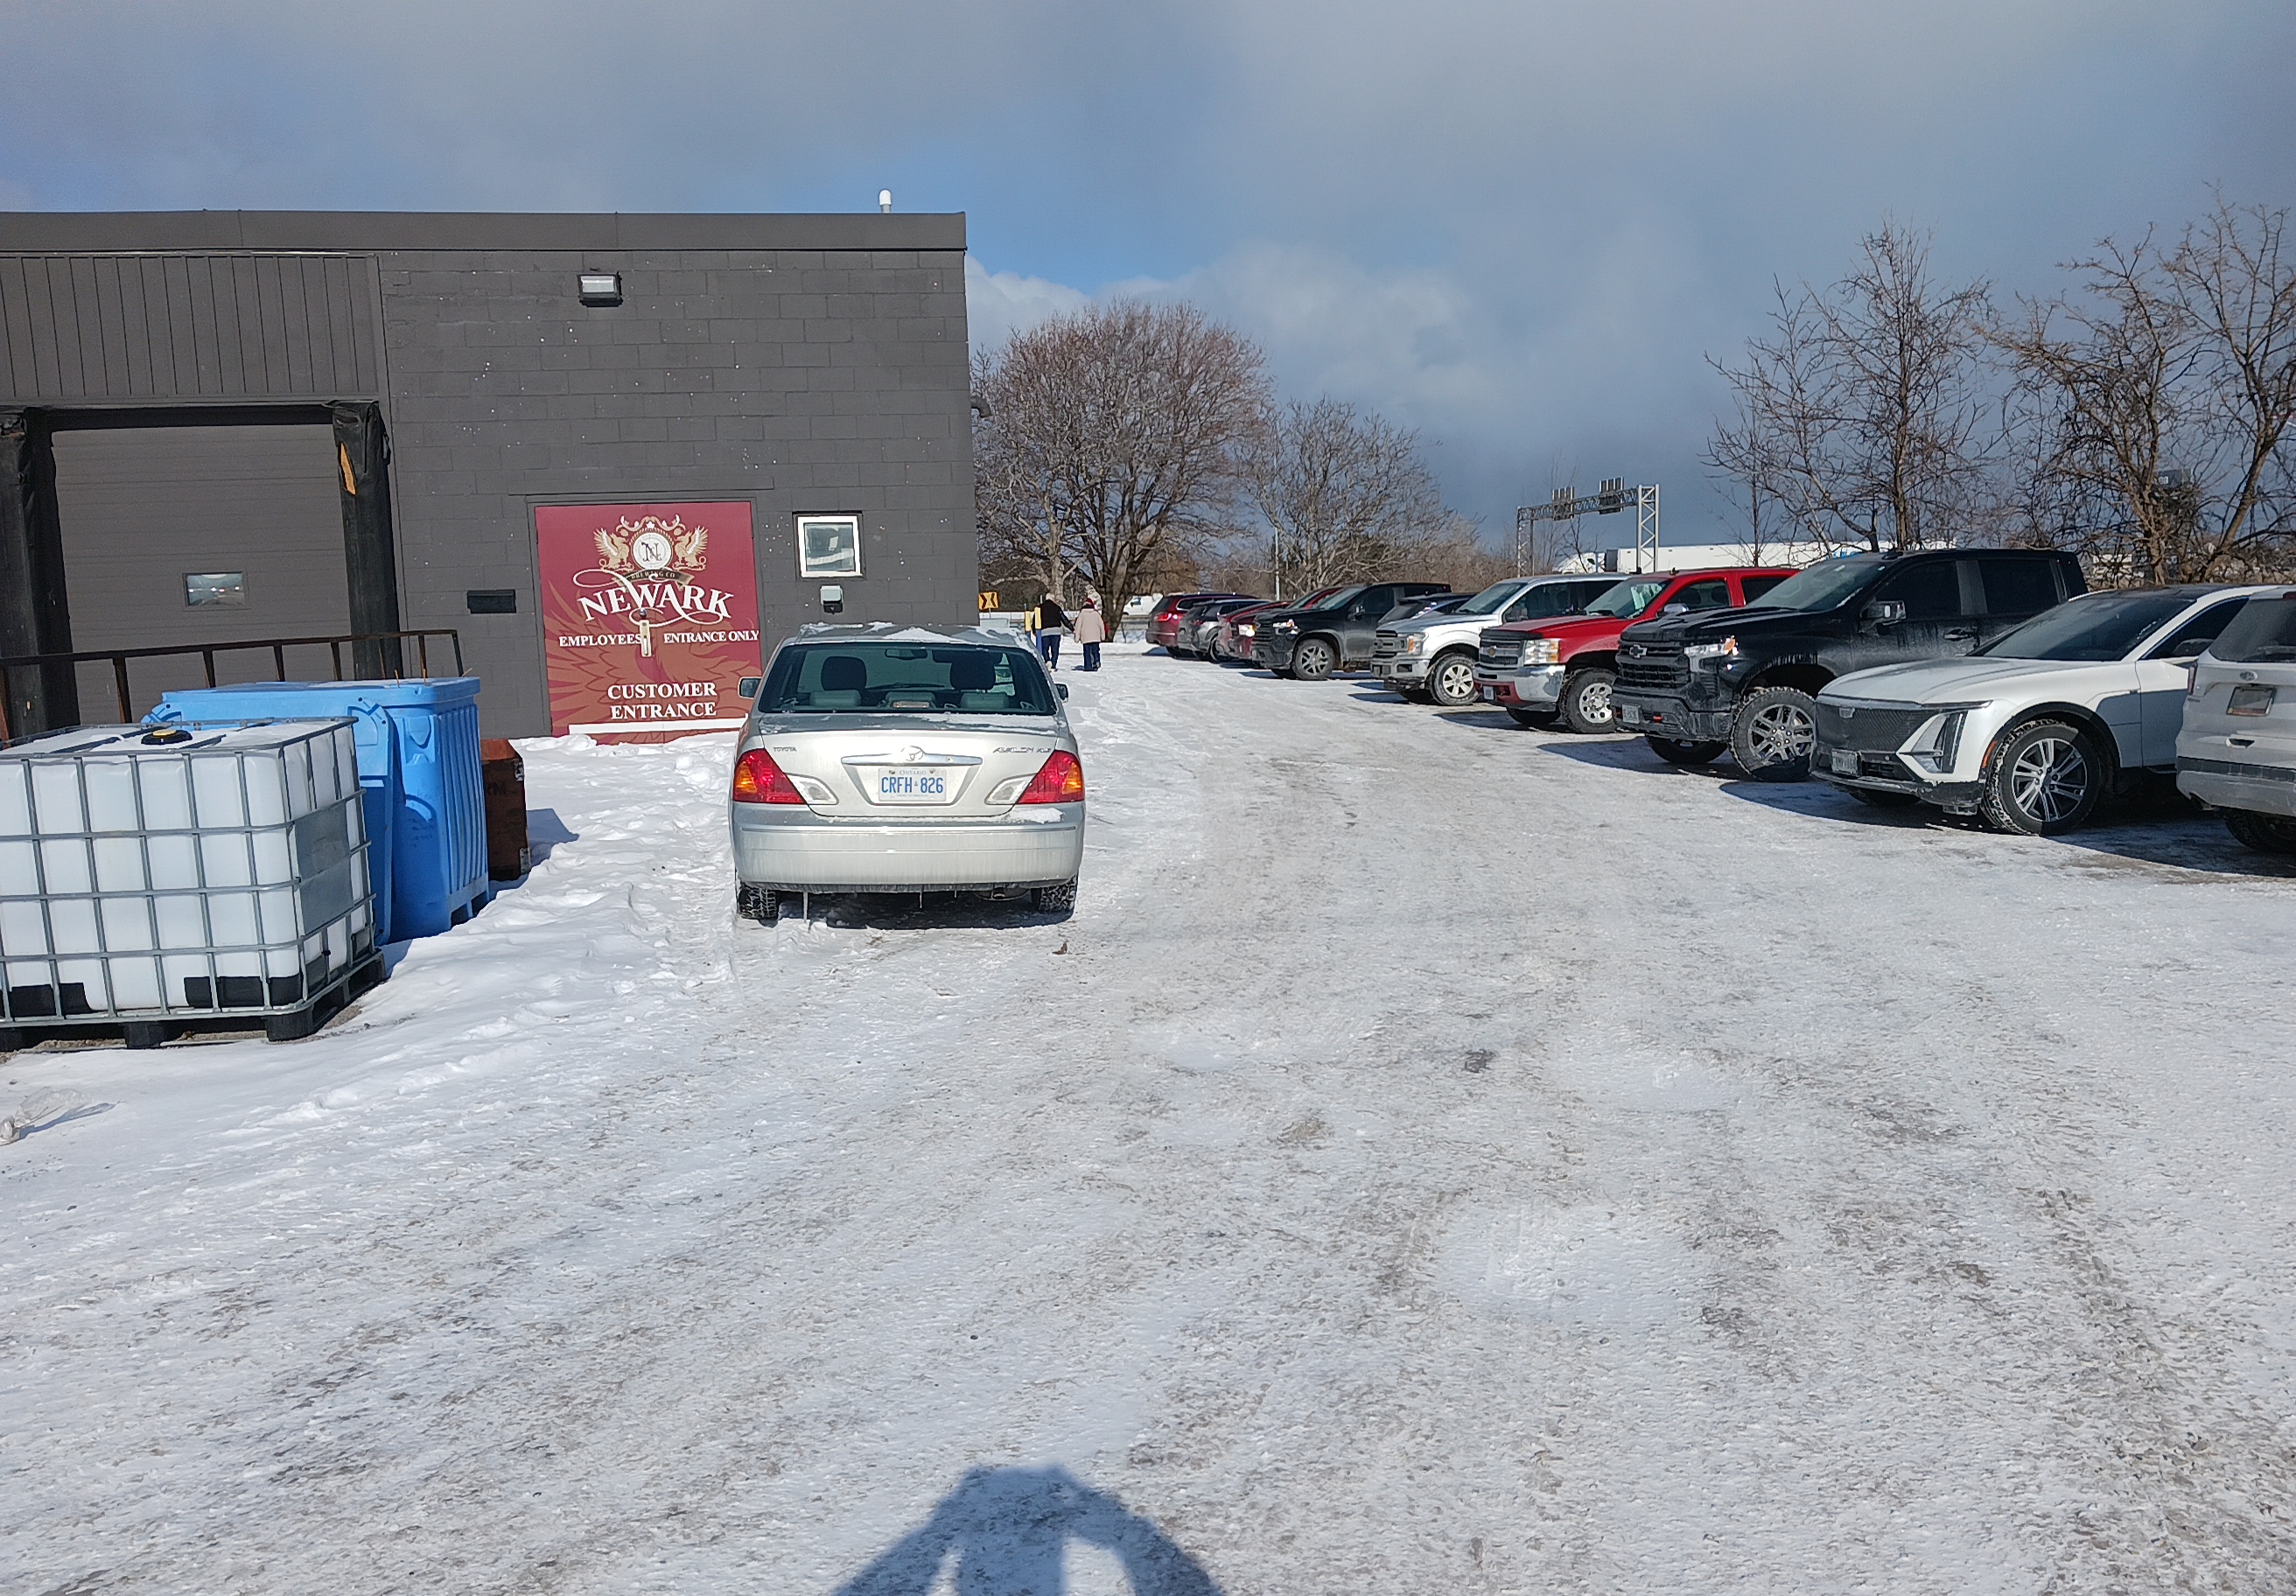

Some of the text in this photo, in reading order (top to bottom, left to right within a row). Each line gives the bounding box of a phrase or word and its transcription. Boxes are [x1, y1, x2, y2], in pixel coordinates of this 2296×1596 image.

[577, 579, 734, 623] NEWARK
[558, 630, 760, 648] EMPLOYEES ENTRANCE ONLY
[607, 682, 718, 700] CUSTOMER
[610, 701, 717, 720] ENTRANCE
